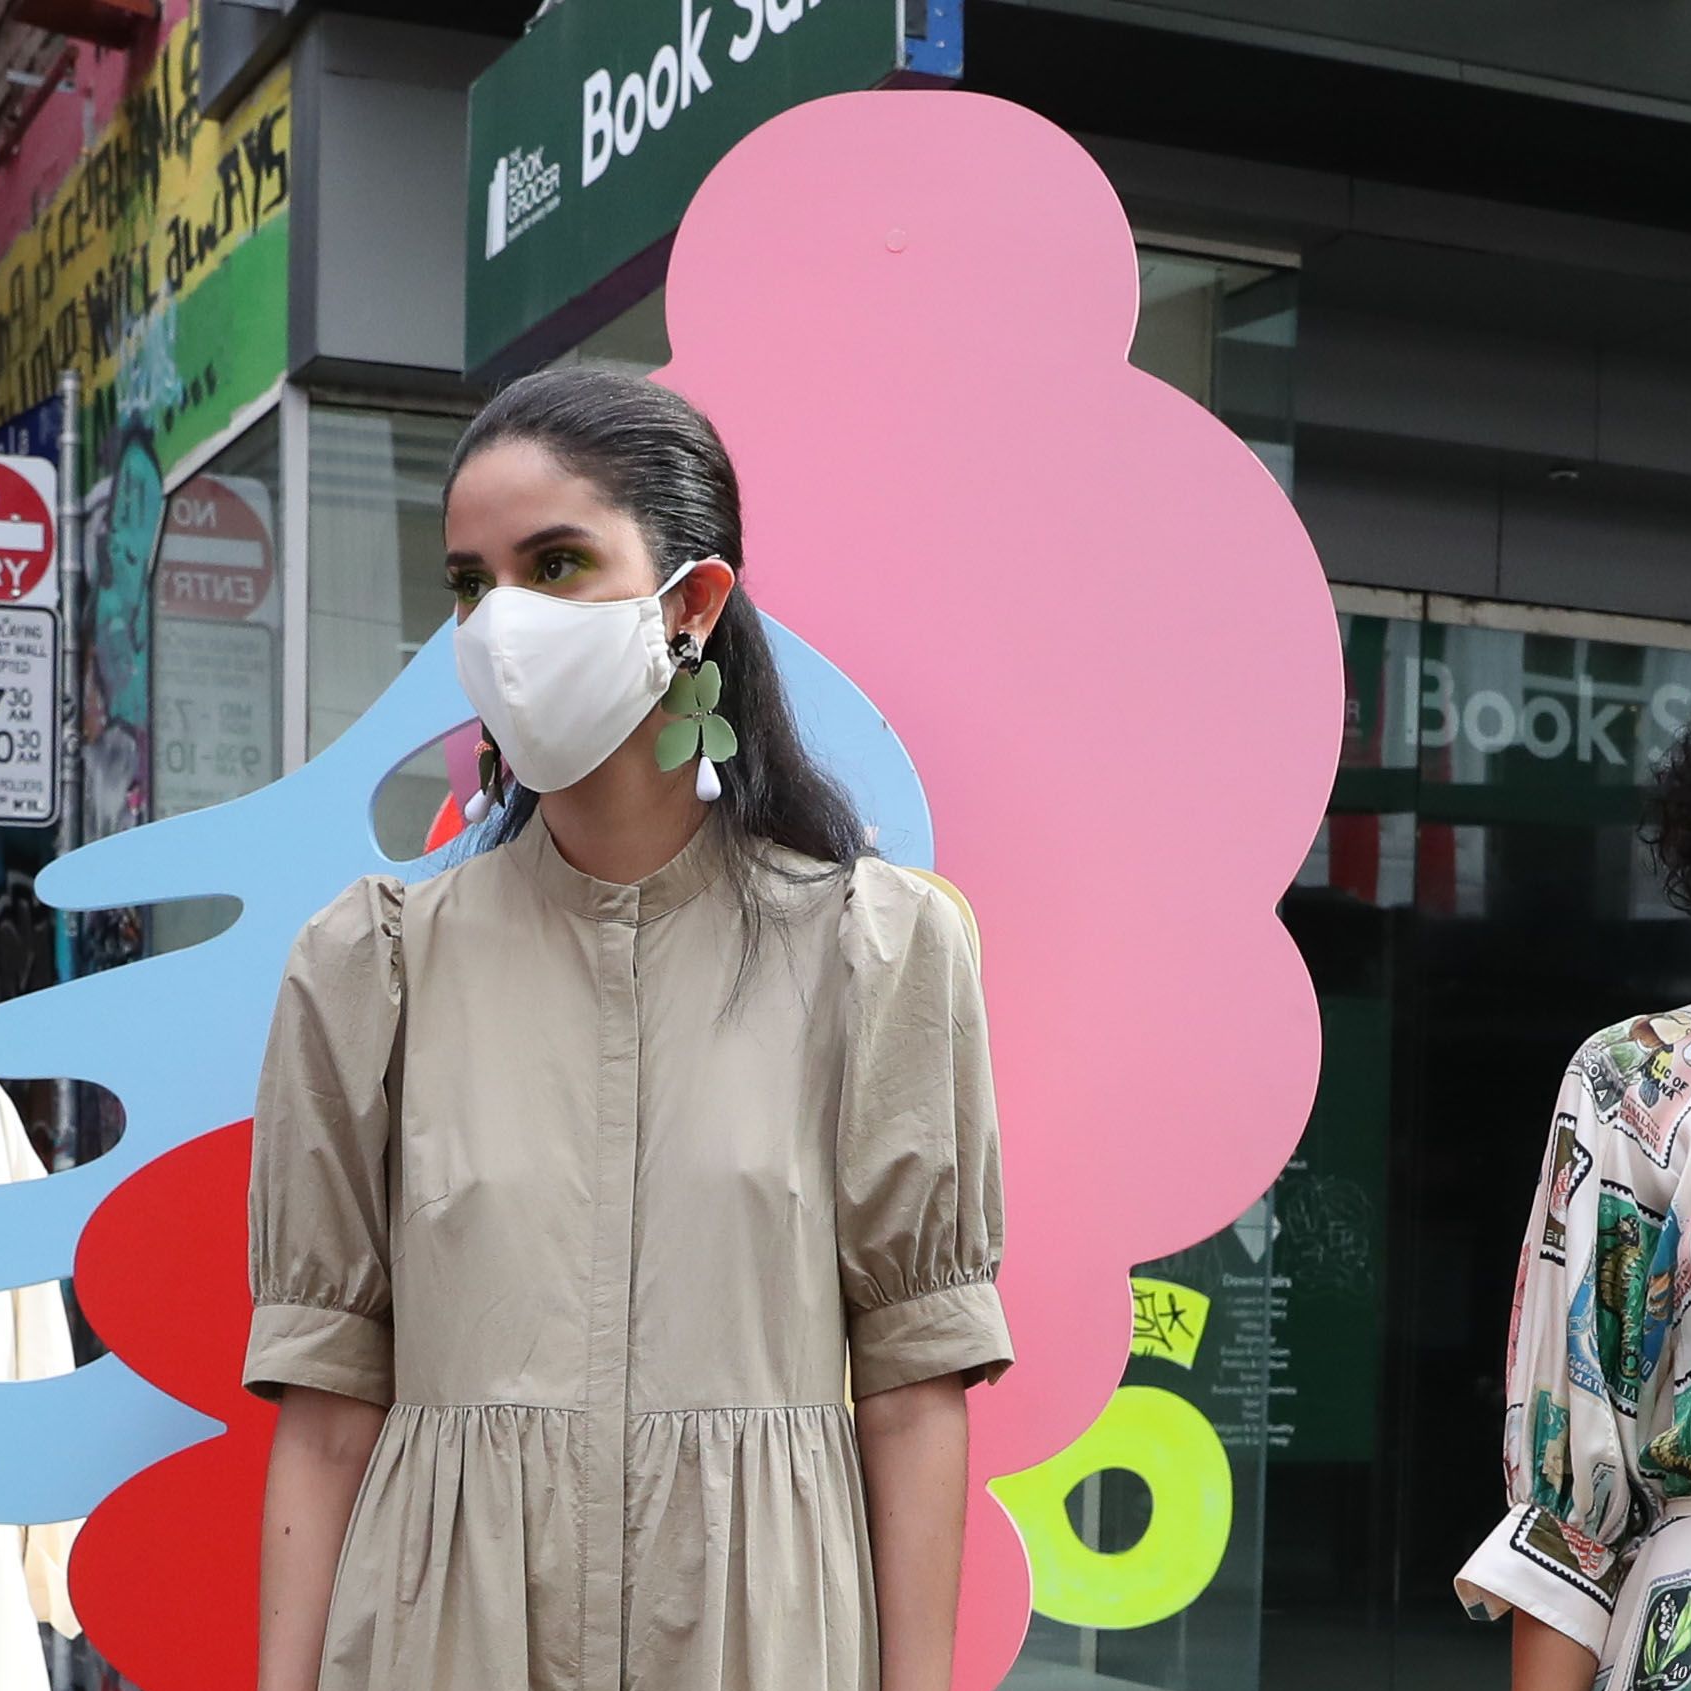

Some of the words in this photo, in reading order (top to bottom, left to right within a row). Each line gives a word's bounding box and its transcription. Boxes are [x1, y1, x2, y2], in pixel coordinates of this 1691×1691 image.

[582, 0, 713, 187] Book
[728, 0, 821, 63] Sa
[508, 144, 545, 196] BOOK
[508, 162, 561, 224] GROCER
[7, 687, 33, 707] 30
[8, 710, 32, 721] AM
[1403, 656, 1628, 766] Book
[16, 729, 42, 749] 30
[17, 752, 41, 762] AM
[1672, 1077, 1690, 1092] OF
[1221, 1273, 1293, 1288] Downsairs
